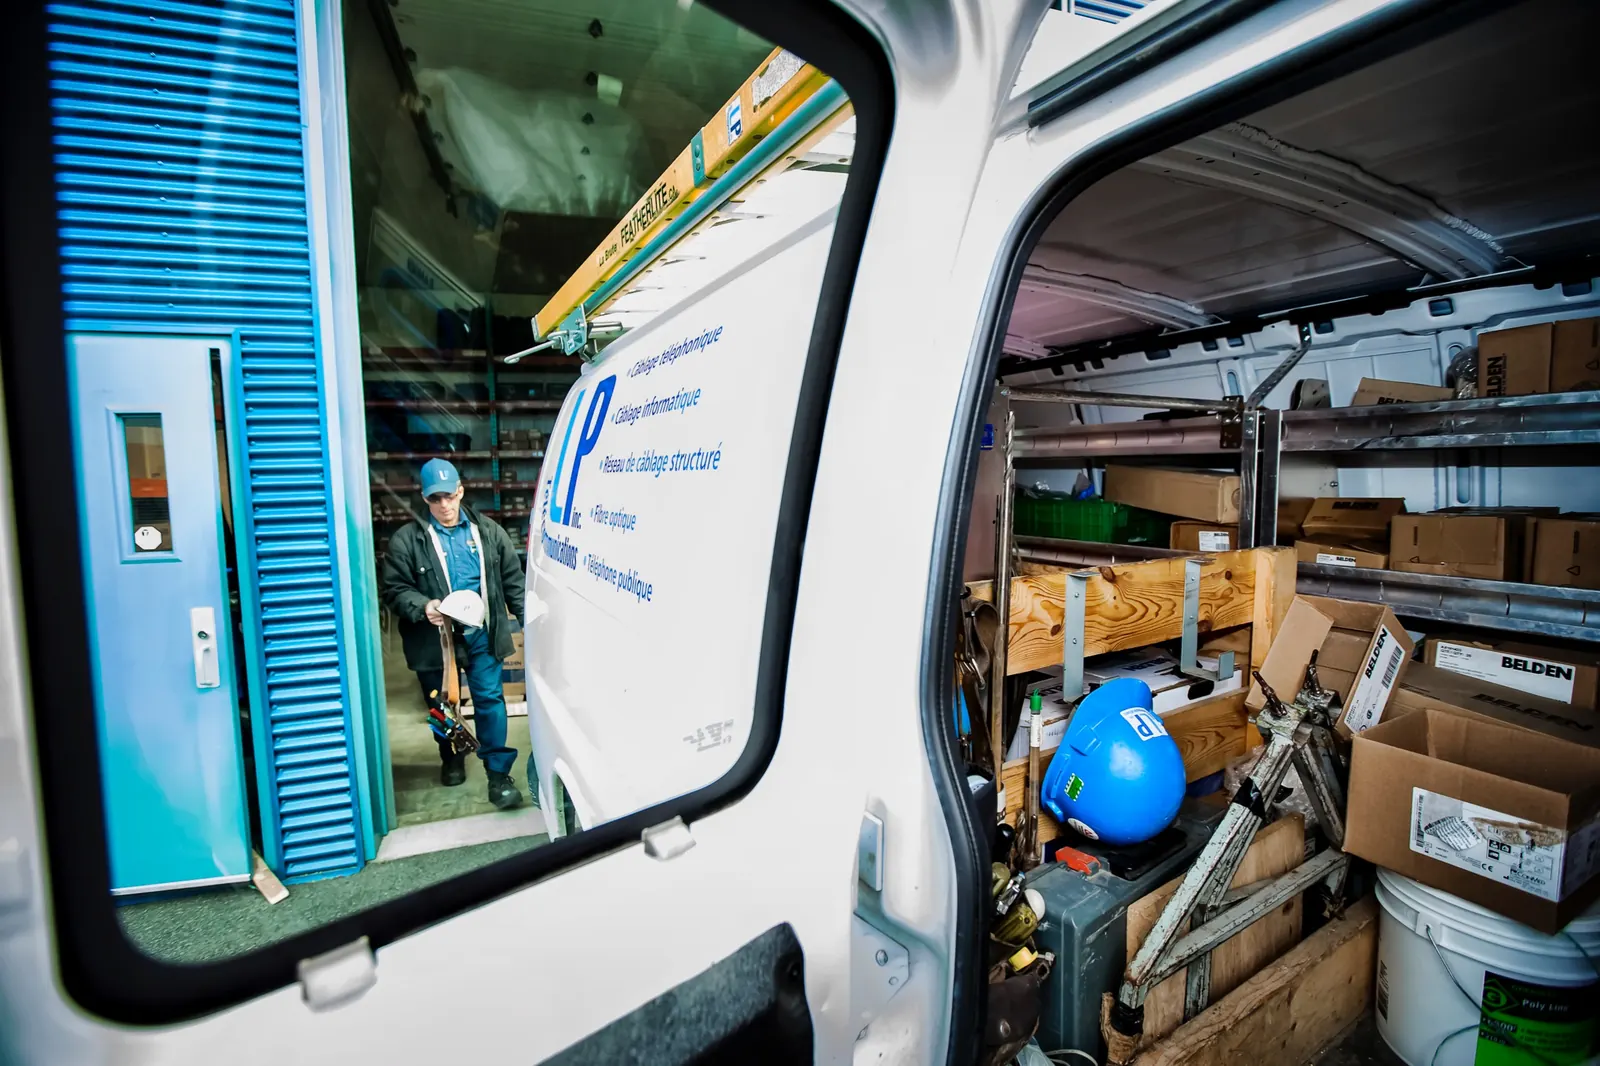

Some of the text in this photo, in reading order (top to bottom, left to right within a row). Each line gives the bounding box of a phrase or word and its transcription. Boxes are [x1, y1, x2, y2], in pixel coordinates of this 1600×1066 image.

[630, 325, 723, 378] Câblage téléphonique
[1487, 356, 1502, 396] ELDEN
[615, 387, 701, 426] Câblage informatique
[602, 441, 723, 478] Réseau de câblage structuré
[571, 506, 582, 529] inc.
[593, 503, 637, 534] Fibre optique
[587, 553, 653, 604] Téléphone publique
[1364, 628, 1389, 680] BELDEN
[1501, 656, 1573, 681] BELDEN
[1522, 998, 1546, 1011] Poly
